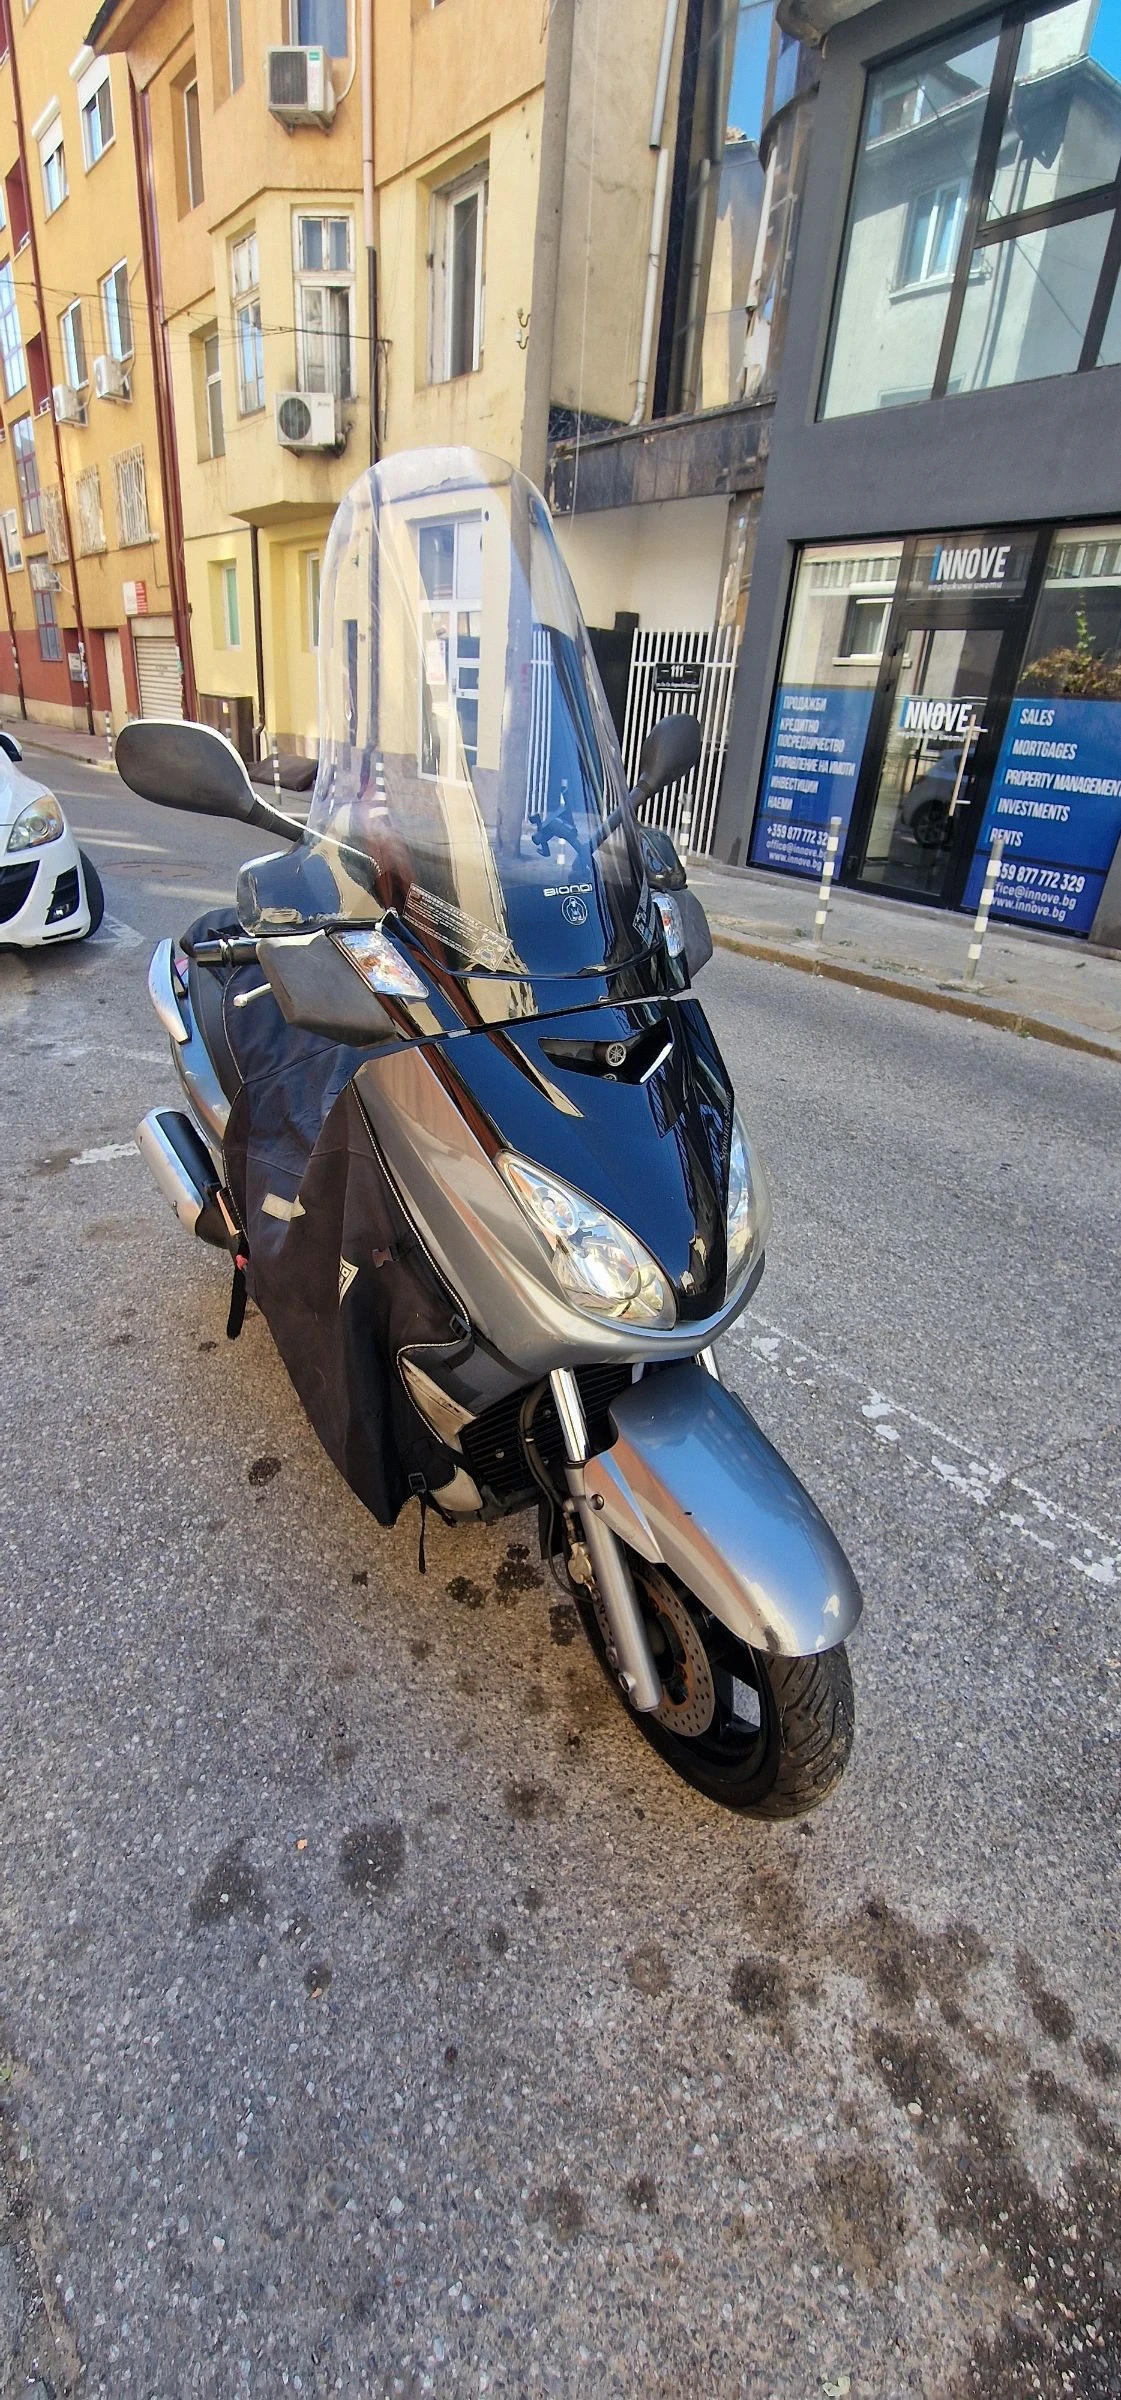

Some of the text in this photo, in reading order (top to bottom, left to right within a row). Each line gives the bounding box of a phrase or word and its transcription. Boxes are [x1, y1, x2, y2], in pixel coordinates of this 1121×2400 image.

[930, 544, 1011, 584] INNOVE
[671, 664, 684, 678] 111
[783, 695, 827, 712] ПРОДАЖБИ
[898, 697, 973, 733] INNOVE
[1020, 708, 1055, 726] SALES
[780, 718, 820, 733] КРЕДИТНО
[777, 734, 845, 752] ПОСРЕДНИЧЕСТВО
[1012, 739, 1077, 760] MORTGAGES
[774, 755, 856, 776] УПРАВЛЕНИЕ НА ИМОТИ
[770, 775, 819, 794] ИНВЕСТИЦИИ
[1004, 768, 1055, 789] PROPERTY
[767, 795, 793, 811] НАЕМИ
[997, 797, 1071, 822] INVESTMENTS
[767, 823, 829, 846] +359 877 772 32
[989, 827, 1024, 847] RENTS
[769, 852, 822, 872] www.innove.bg
[1016, 866, 1040, 885] 877
[1038, 869, 1061, 889] 772
[1060, 873, 1086, 893] 329
[543, 883, 593, 897] BIONDI
